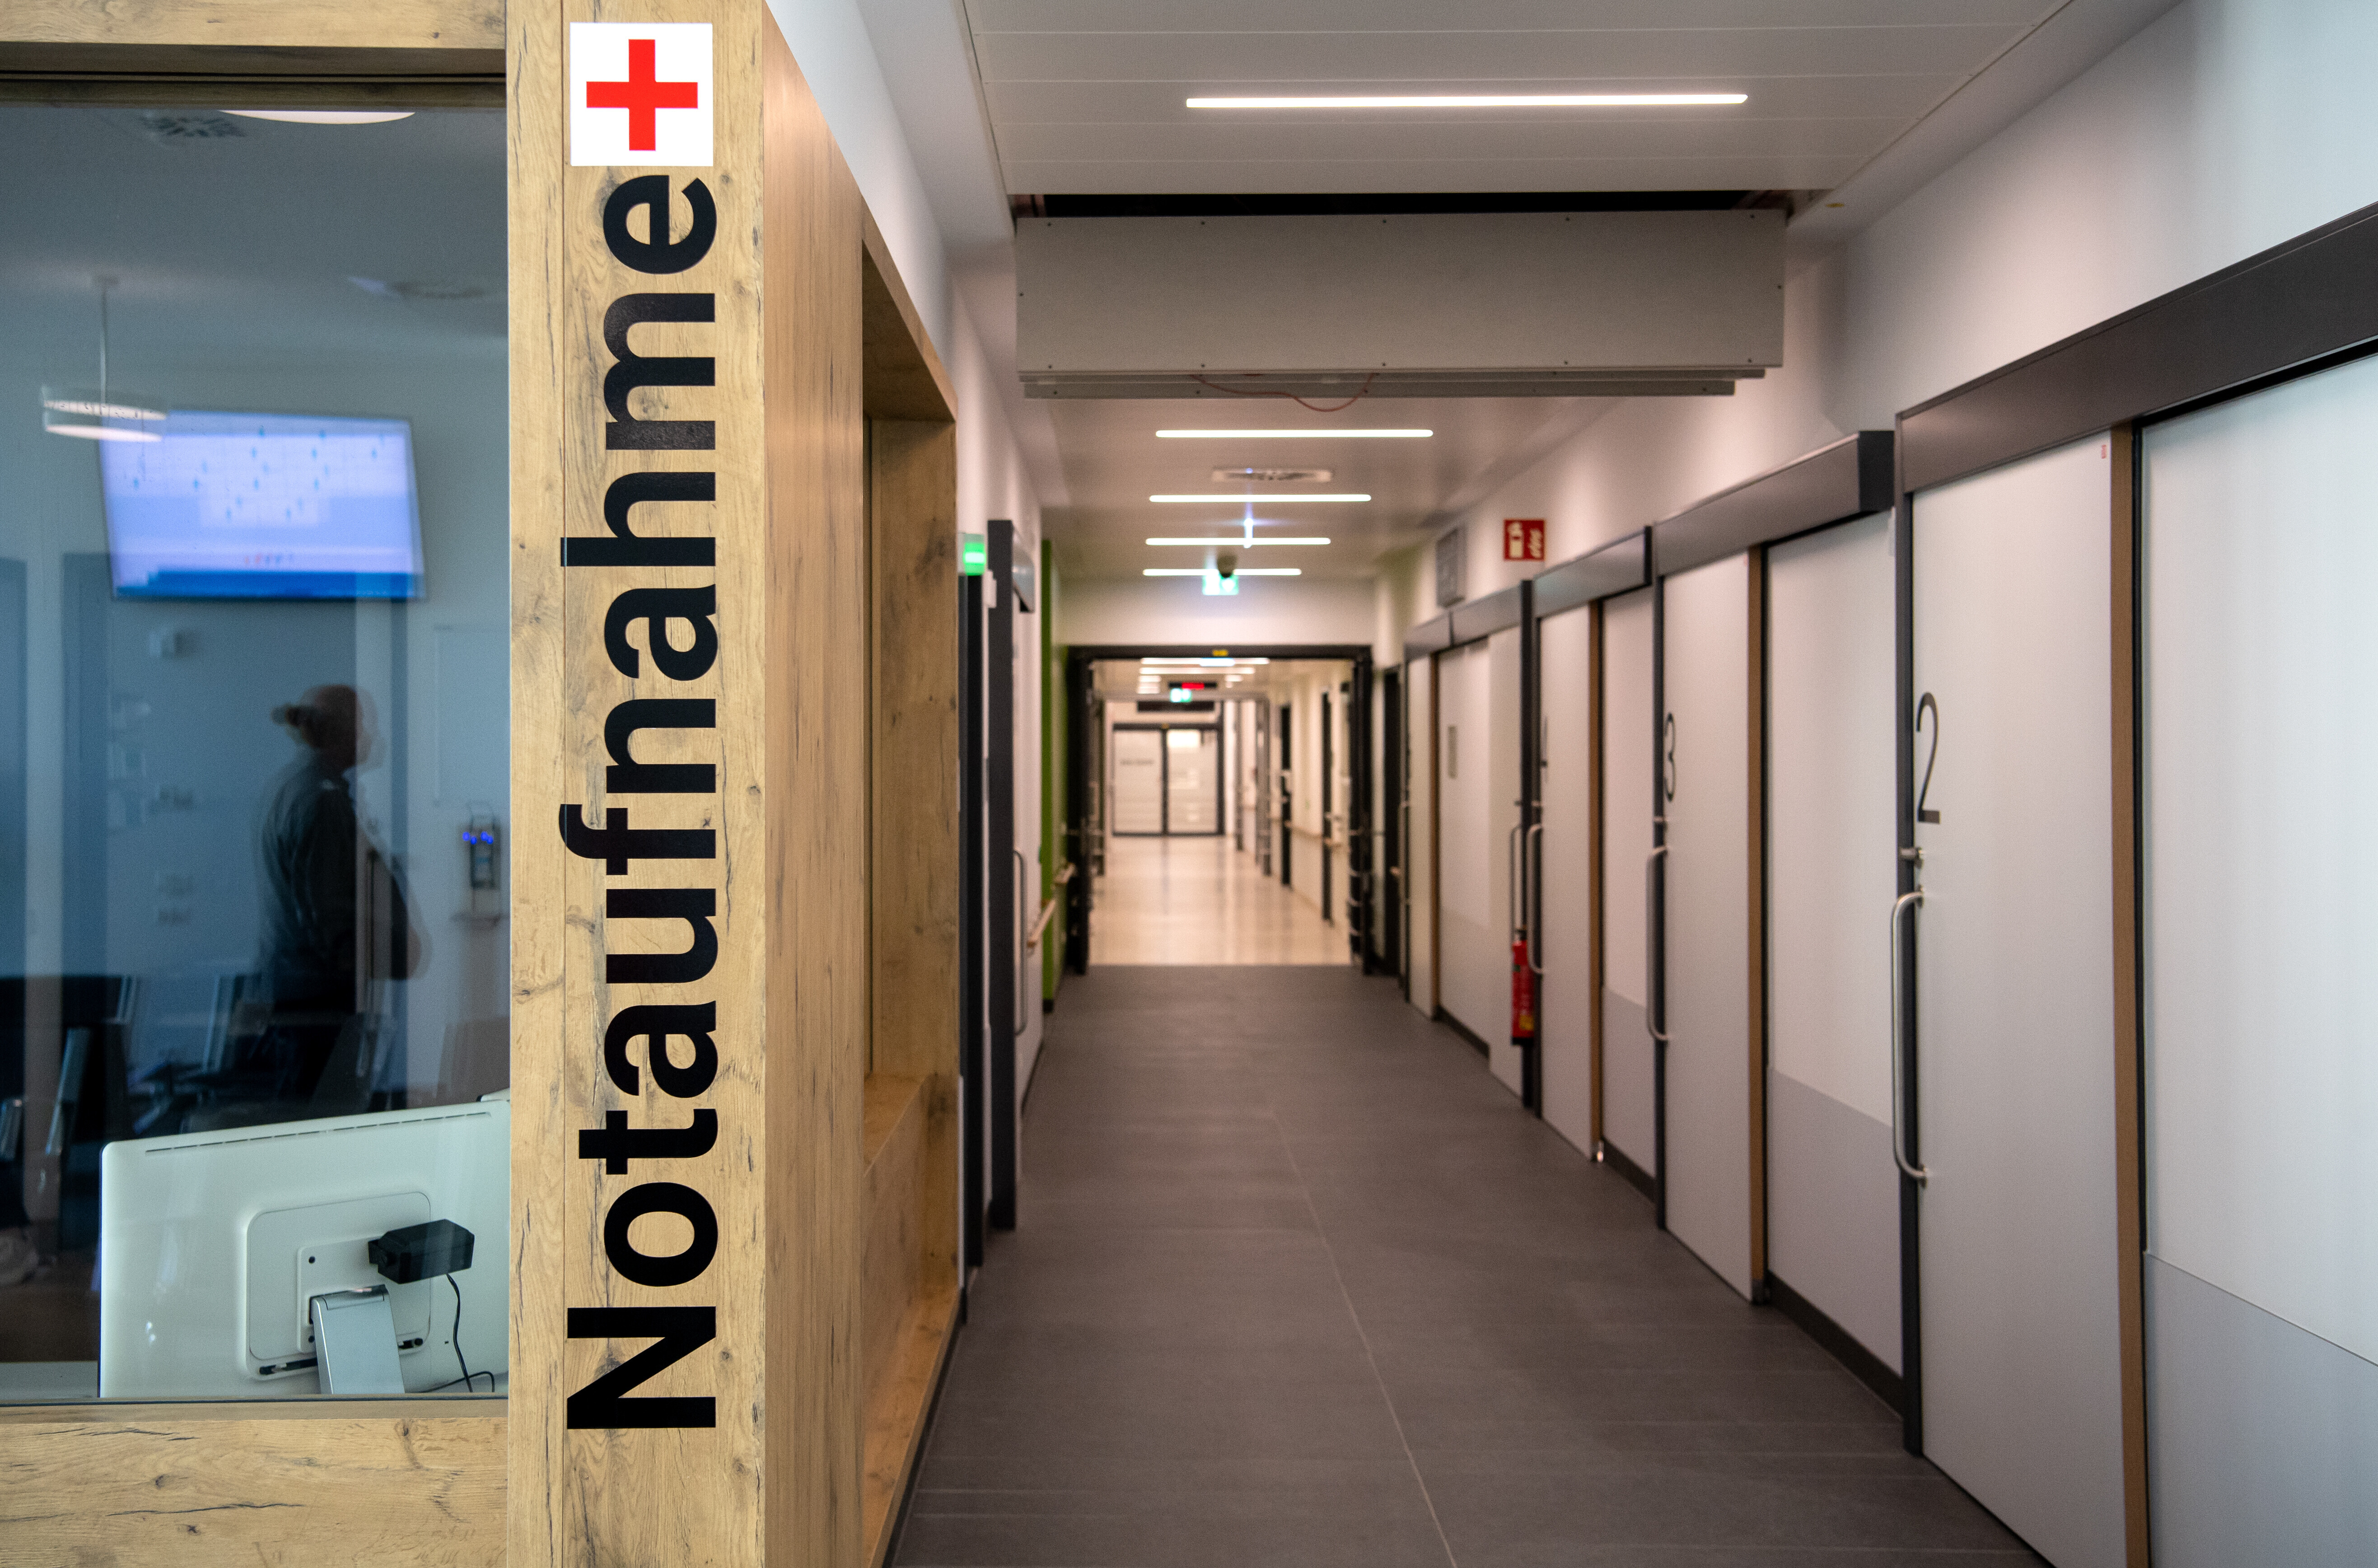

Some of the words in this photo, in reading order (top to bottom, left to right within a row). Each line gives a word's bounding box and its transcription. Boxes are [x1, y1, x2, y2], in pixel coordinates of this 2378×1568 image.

[559, 175, 718, 1429] Notaufnahme
[1664, 712, 1676, 803] 3
[1916, 691, 1941, 824] 2
